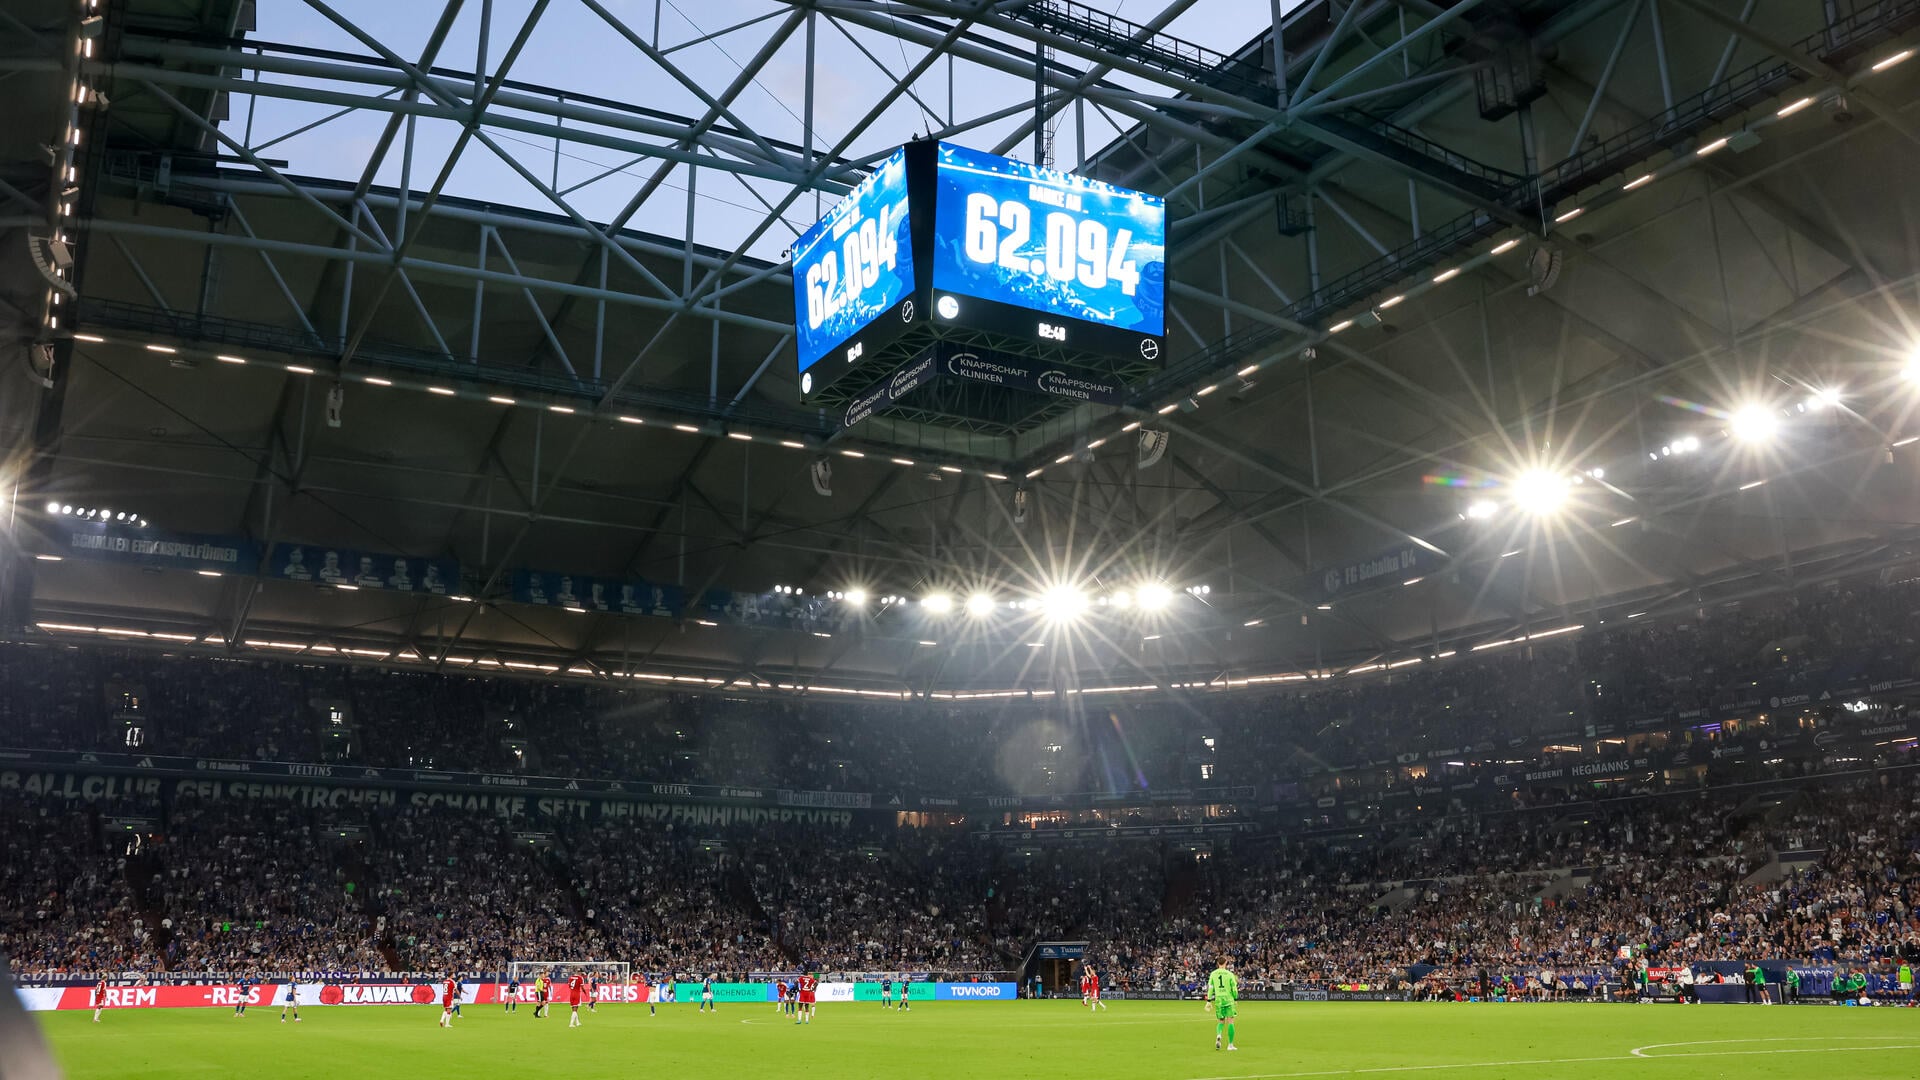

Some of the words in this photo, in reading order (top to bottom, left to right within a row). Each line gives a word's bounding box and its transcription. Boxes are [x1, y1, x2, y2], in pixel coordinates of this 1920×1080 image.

[966, 193, 1139, 296] 62.094
[807, 204, 897, 329] 62.094
[895, 358, 931, 387] KNAPPSCHAFT
[960, 359, 1028, 378] KNAPPSCHAFT
[960, 369, 1003, 383] KLINIKEN
[895, 378, 918, 397] KLINIKEN
[1048, 375, 1114, 394] KNAPPSCHAFT
[1049, 385, 1090, 399] KLINIKEN
[851, 389, 885, 415] KNAPPSCHAFT
[851, 407, 872, 425] KLINIKEN
[1360, 556, 1399, 580] Schalke
[1401, 549, 1416, 568] 04
[288, 765, 333, 777] VELTINS
[1571, 760, 1630, 776] HEGMANNS
[652, 785, 690, 795] VELTINS
[176, 779, 396, 808] GELSENKIRCHEN
[410, 791, 526, 818] SCHALKE
[537, 798, 591, 820] SEIT
[1218, 975, 1225, 988] 1
[204, 986, 261, 1004] -RES
[343, 986, 413, 1003] KAVAK
[832, 987, 847, 996] bis
